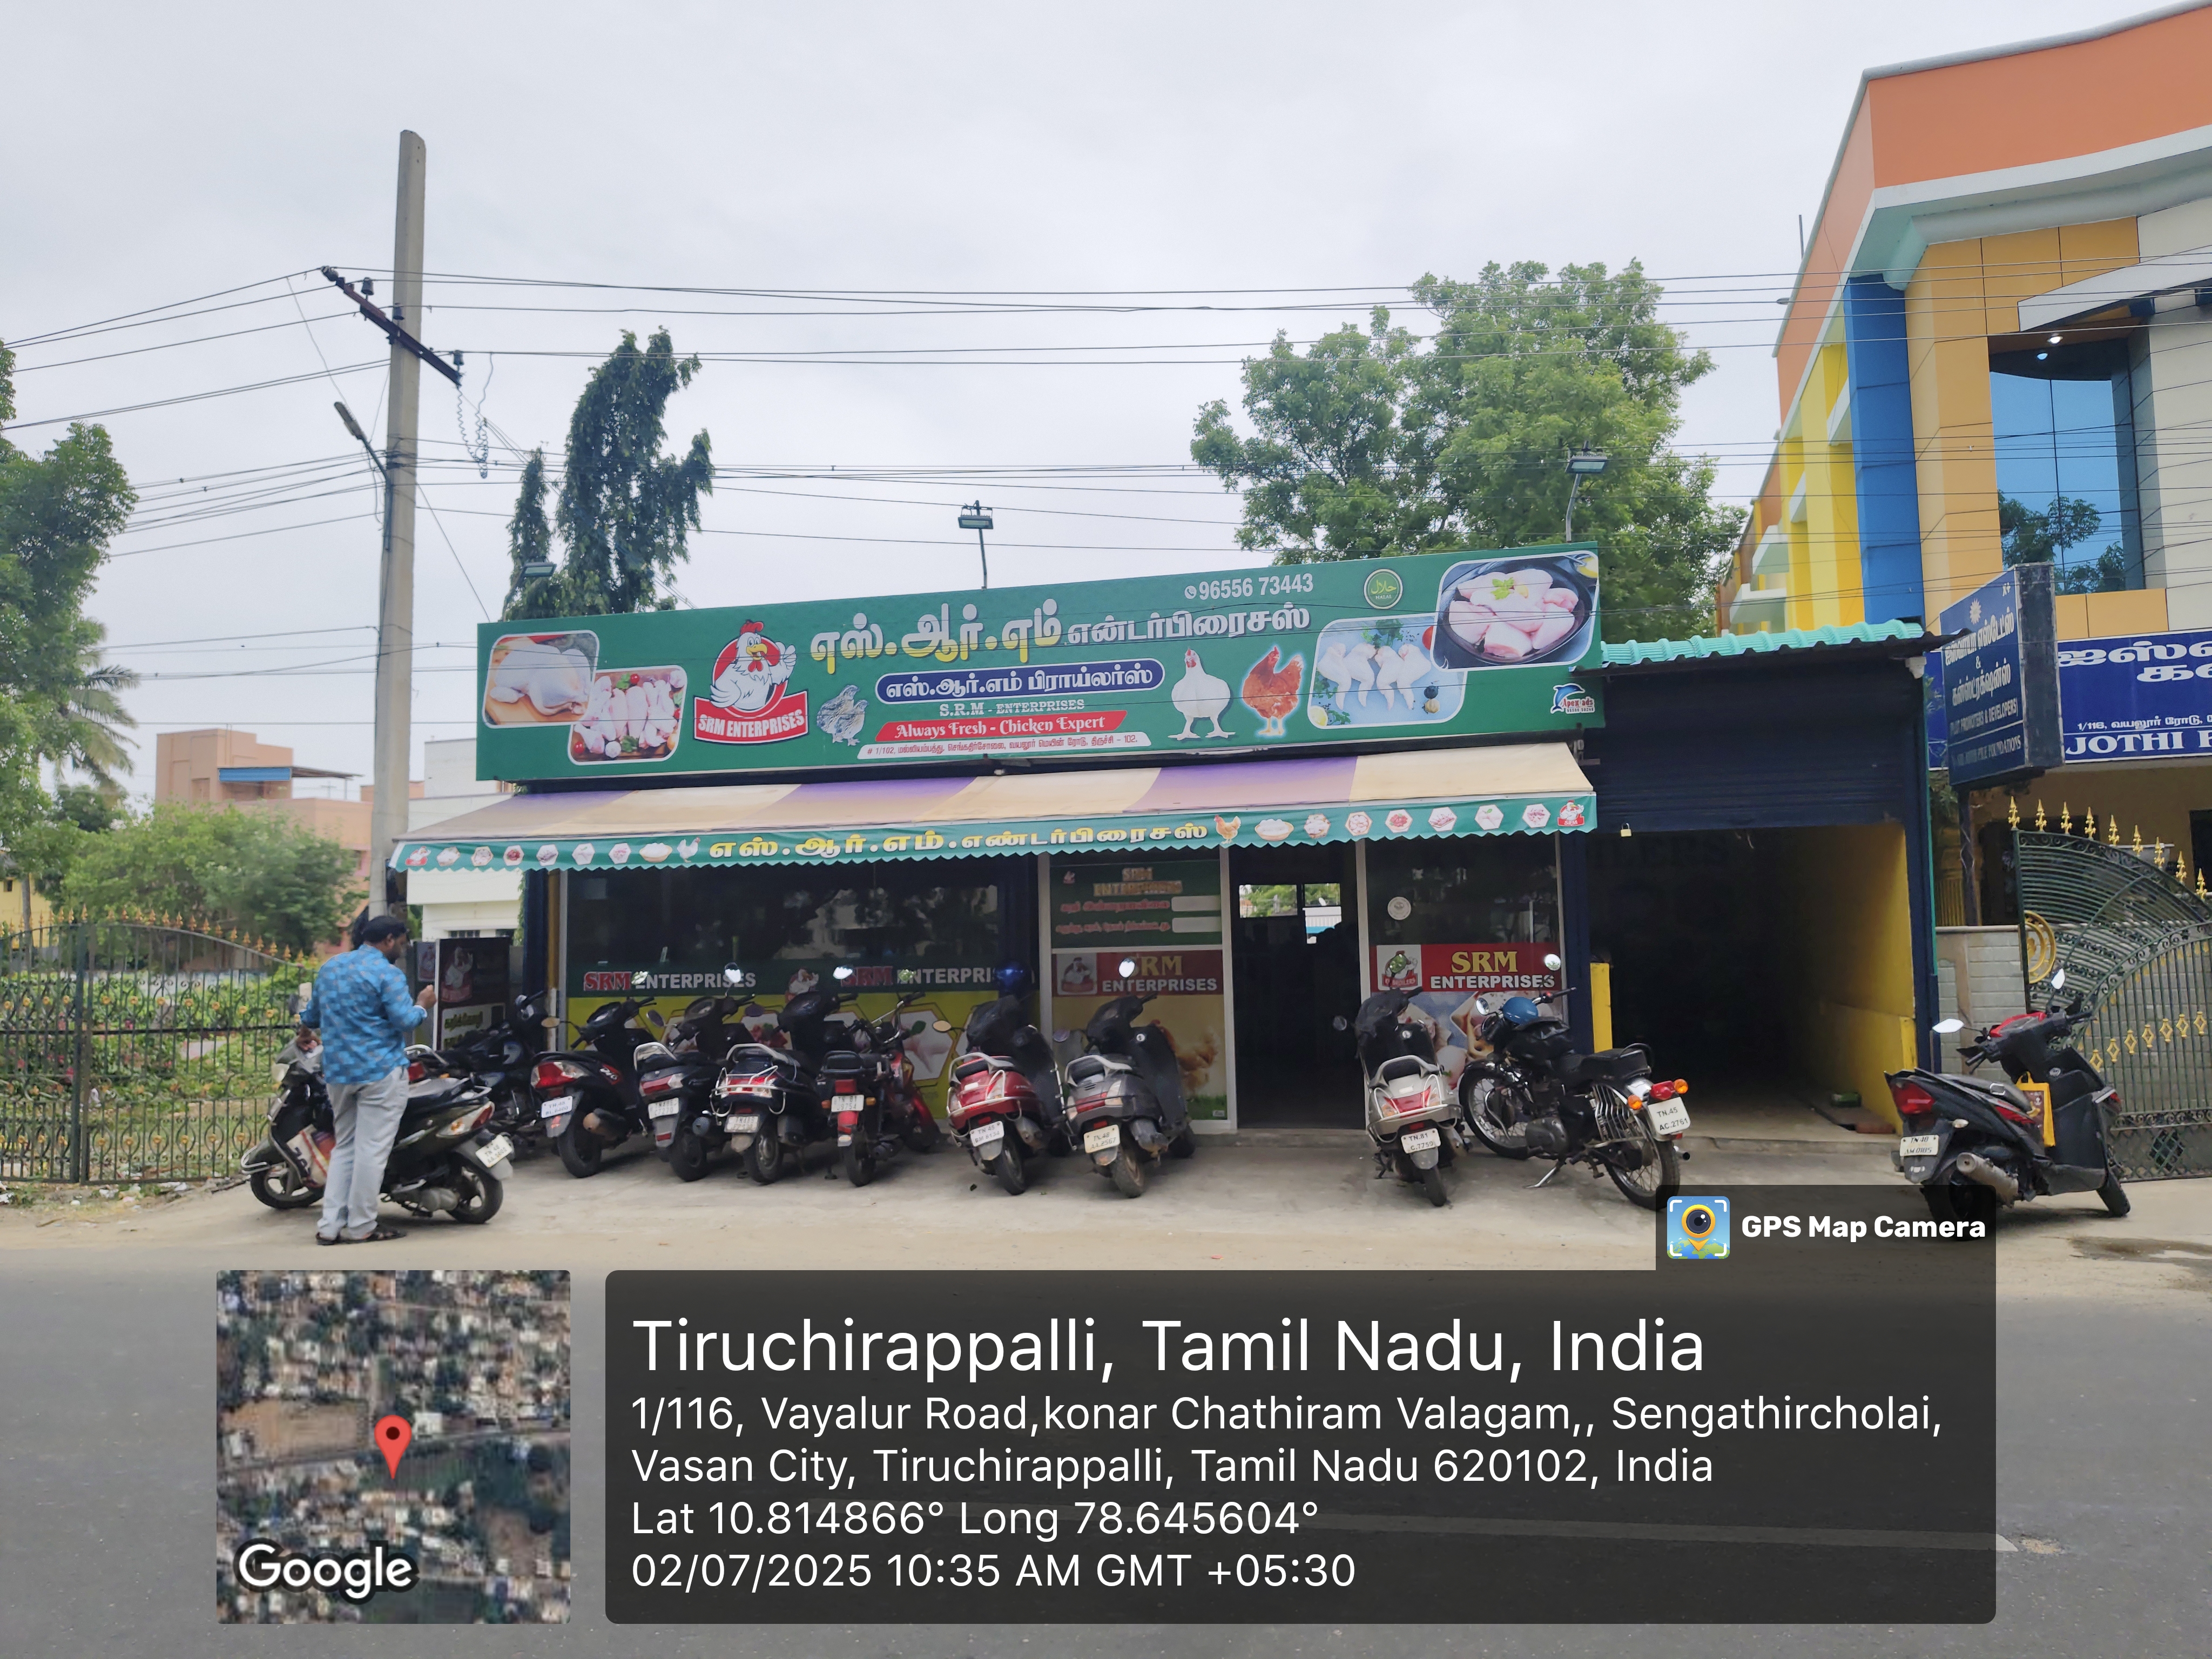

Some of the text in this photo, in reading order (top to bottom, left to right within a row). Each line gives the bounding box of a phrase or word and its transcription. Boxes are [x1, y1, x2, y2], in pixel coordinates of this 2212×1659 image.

[1199, 573, 1313, 600] 96556 73443
[1371, 579, 1397, 595] حلال
[1067, 602, 1310, 644] என்டர்பிரைசஸ்
[1975, 656, 1981, 669] &
[886, 663, 1153, 698] எஸ்.ஆர்.எம் பிராய்லர்ஸ்
[939, 703, 984, 717] S.R.M
[996, 699, 1085, 714] ENTERPRISES
[1562, 697, 1593, 709] Apex ads
[698, 709, 805, 738] SRM ENTERPRISES
[894, 723, 946, 739] Always
[948, 722, 987, 736] Fresh
[999, 718, 1053, 734] Chicken
[1056, 716, 1105, 733] Expert
[2065, 731, 2185, 755] JOTHI
[1120, 955, 1183, 976] RM
[1451, 951, 1518, 973] SRM
[584, 972, 630, 990] SRM
[1102, 978, 1218, 993] ENTERPRISES
[1430, 974, 1555, 989] ENTERPRISES
[1408, 1132, 1428, 1141] TN.81
